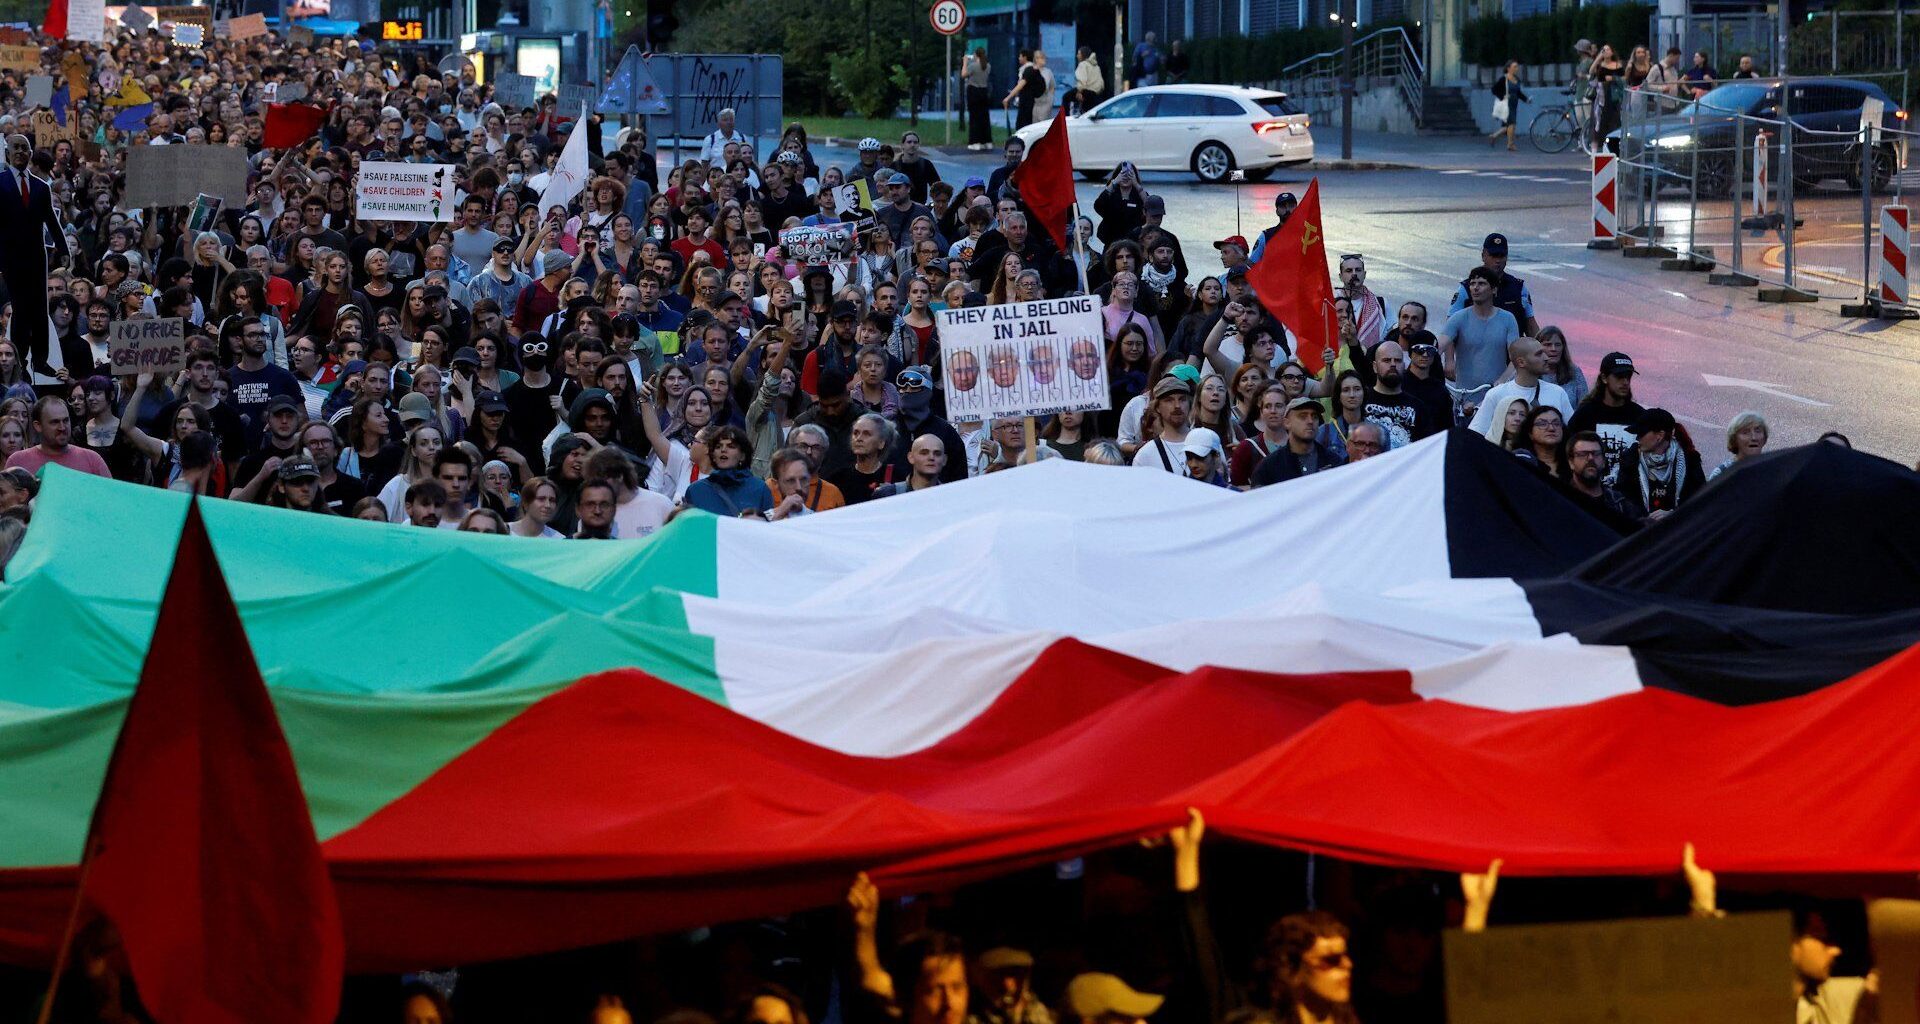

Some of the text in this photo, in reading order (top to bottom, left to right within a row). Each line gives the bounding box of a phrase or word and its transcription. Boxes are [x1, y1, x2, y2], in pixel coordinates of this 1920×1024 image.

[938, 7, 957, 25] 60
[38, 112, 75, 124] KOCA
[364, 172, 428, 183] #SAVE PALESTINE
[363, 186, 425, 197] #SAVE CHILDREN
[362, 201, 427, 212] #SAVE HUMANITY
[781, 231, 842, 243] PODPIRATE
[789, 241, 844, 255] POKOL V
[808, 252, 841, 264] GAZI
[945, 299, 1092, 325] THEY ALL BELONG
[118, 320, 181, 339] NO PRIDE
[993, 320, 1057, 340] IN JAIL
[954, 414, 981, 422] PUTIN
[992, 410, 1022, 418] TRUMP
